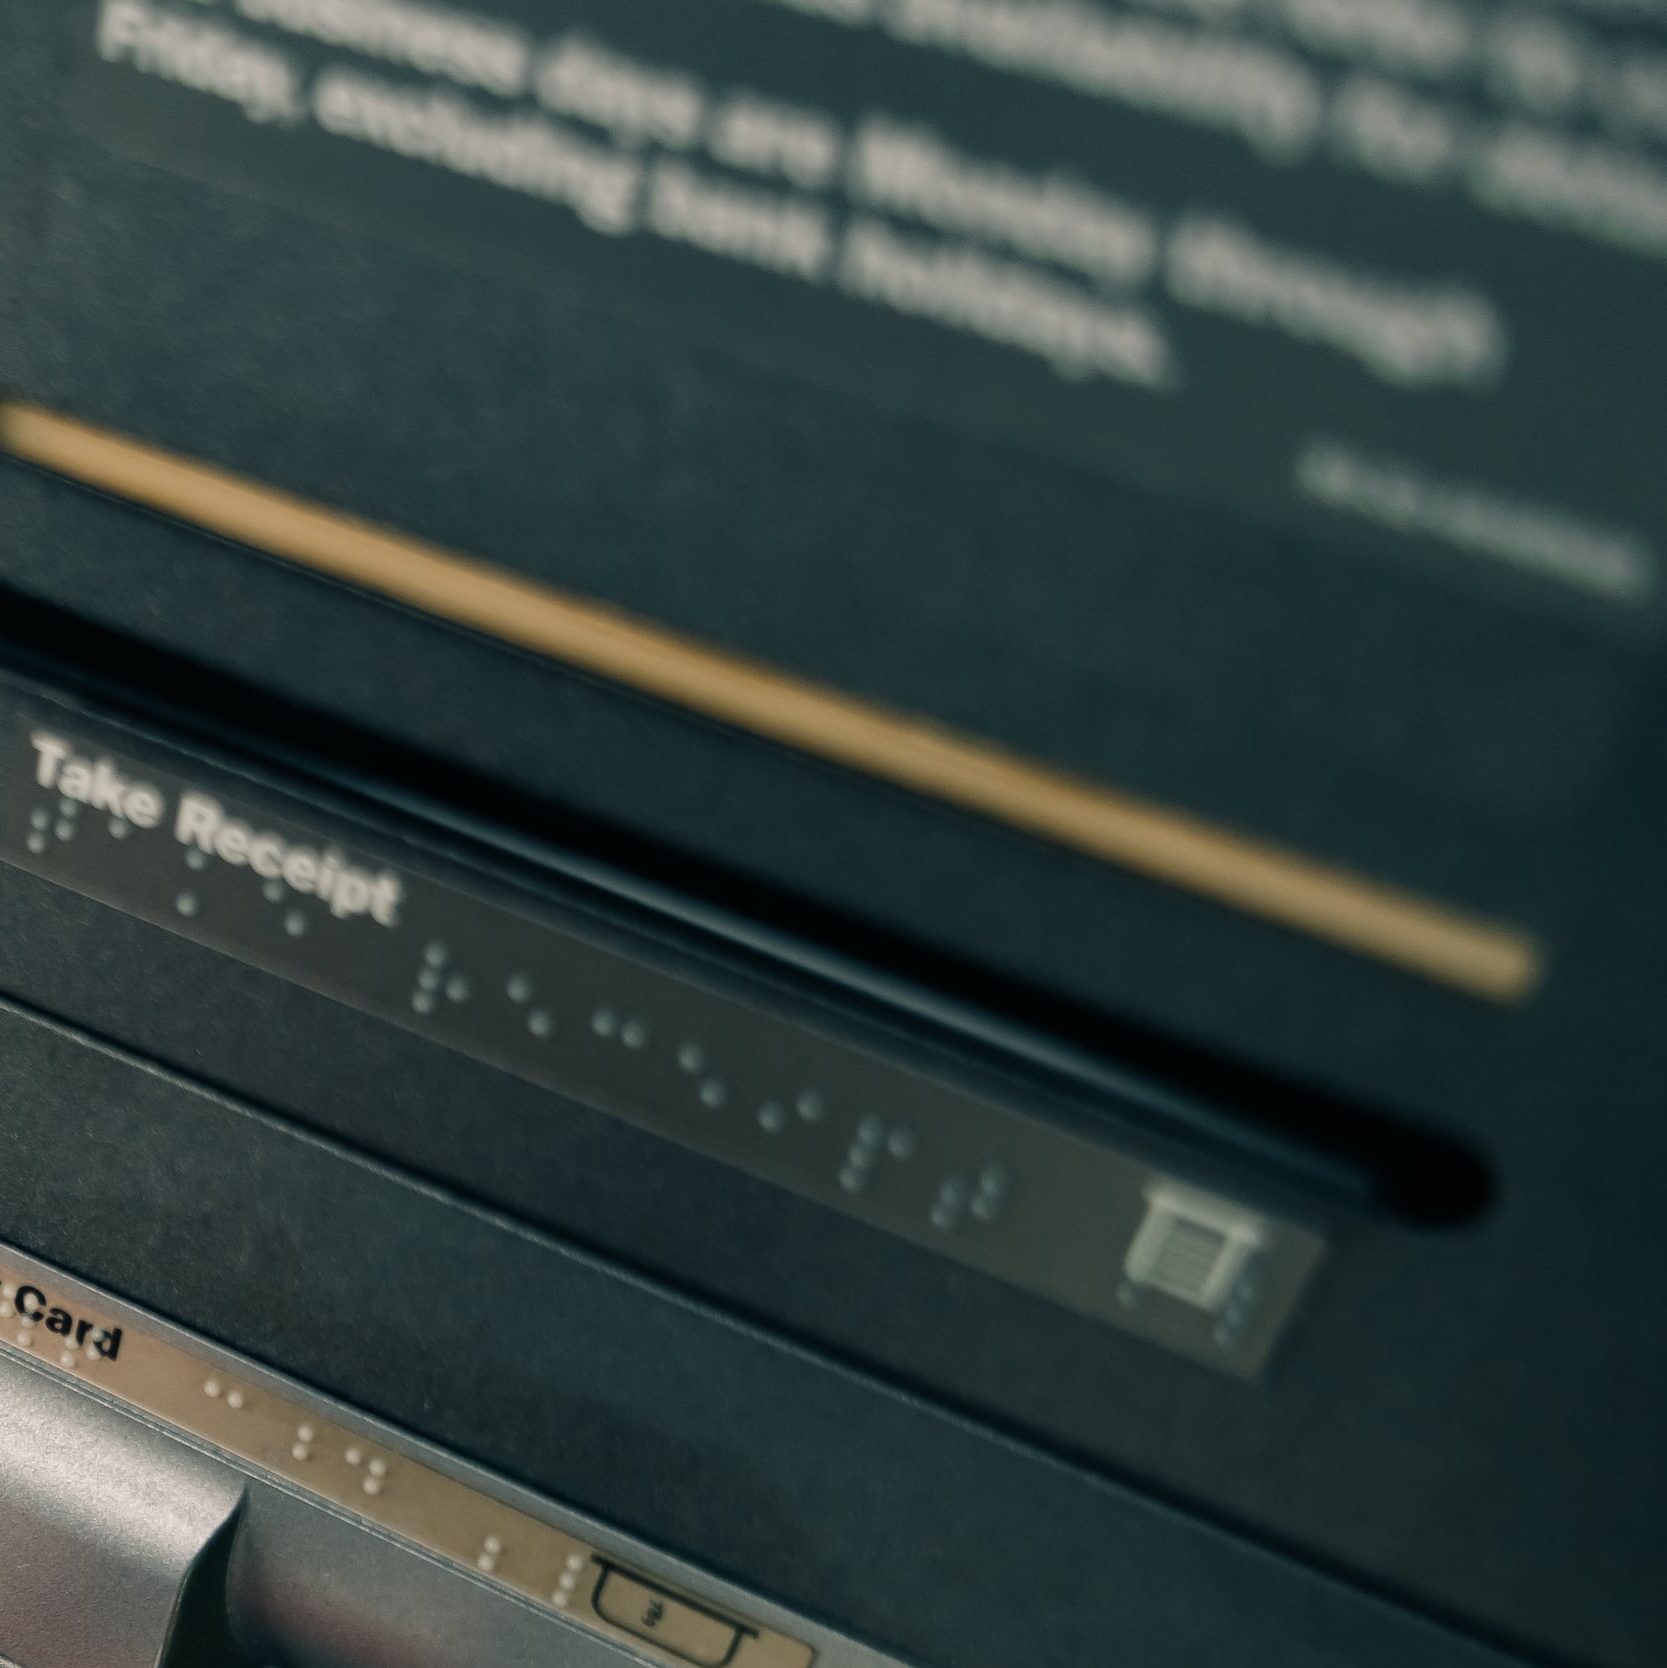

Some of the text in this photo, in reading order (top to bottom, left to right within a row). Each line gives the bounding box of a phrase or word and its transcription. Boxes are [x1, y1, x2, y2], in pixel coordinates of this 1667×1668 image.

[30, 731, 403, 927] Take Receipt
[14, 1285, 122, 1361] Card
